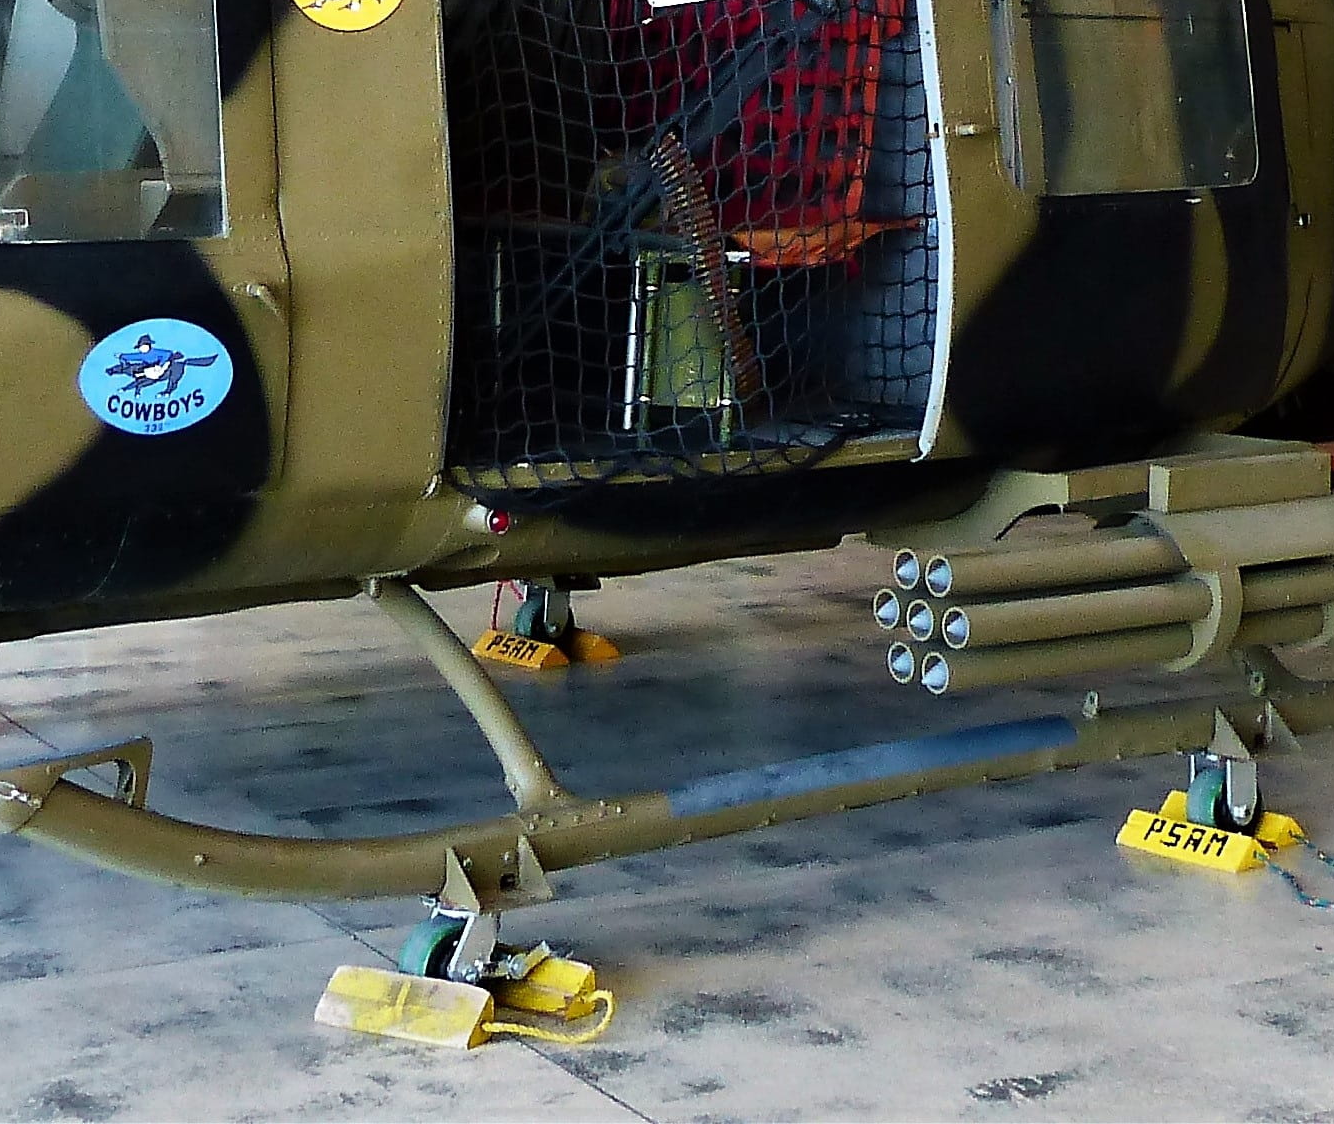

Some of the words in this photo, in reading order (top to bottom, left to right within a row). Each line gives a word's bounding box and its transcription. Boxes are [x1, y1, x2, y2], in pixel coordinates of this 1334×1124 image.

[107, 388, 205, 422] COWBOYS
[485, 634, 540, 661] PSAM
[1143, 818, 1229, 857] PSAM
